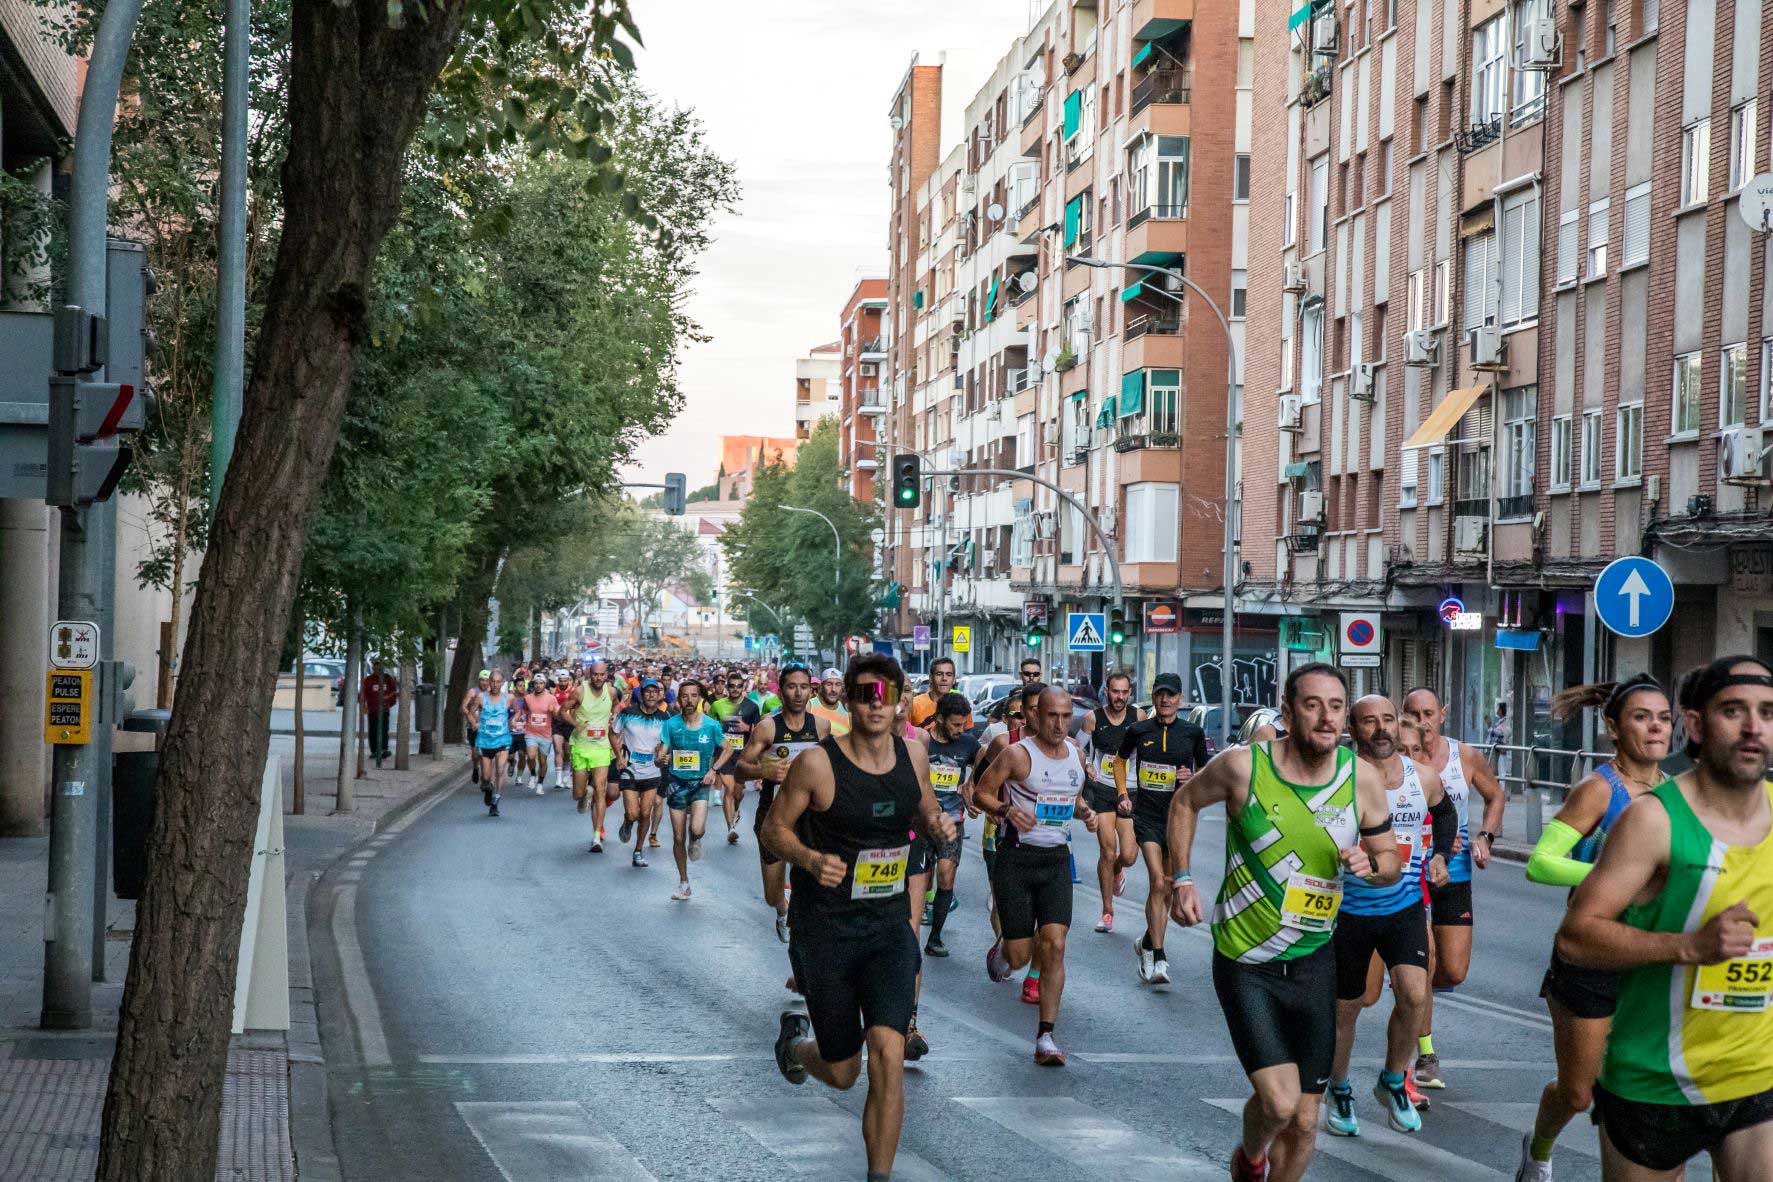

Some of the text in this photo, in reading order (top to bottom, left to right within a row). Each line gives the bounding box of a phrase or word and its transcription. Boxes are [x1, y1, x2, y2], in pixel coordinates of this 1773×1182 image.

[54, 687, 80, 697] PULSE
[51, 704, 80, 713] ESPERE
[51, 715, 80, 724] PEATON
[937, 773, 953, 781] 715
[1147, 771, 1167, 781] 716
[1043, 805, 1071, 816] 1127
[870, 863, 898, 878] 748
[1304, 892, 1333, 911] 763
[1726, 962, 1772, 983] 552
